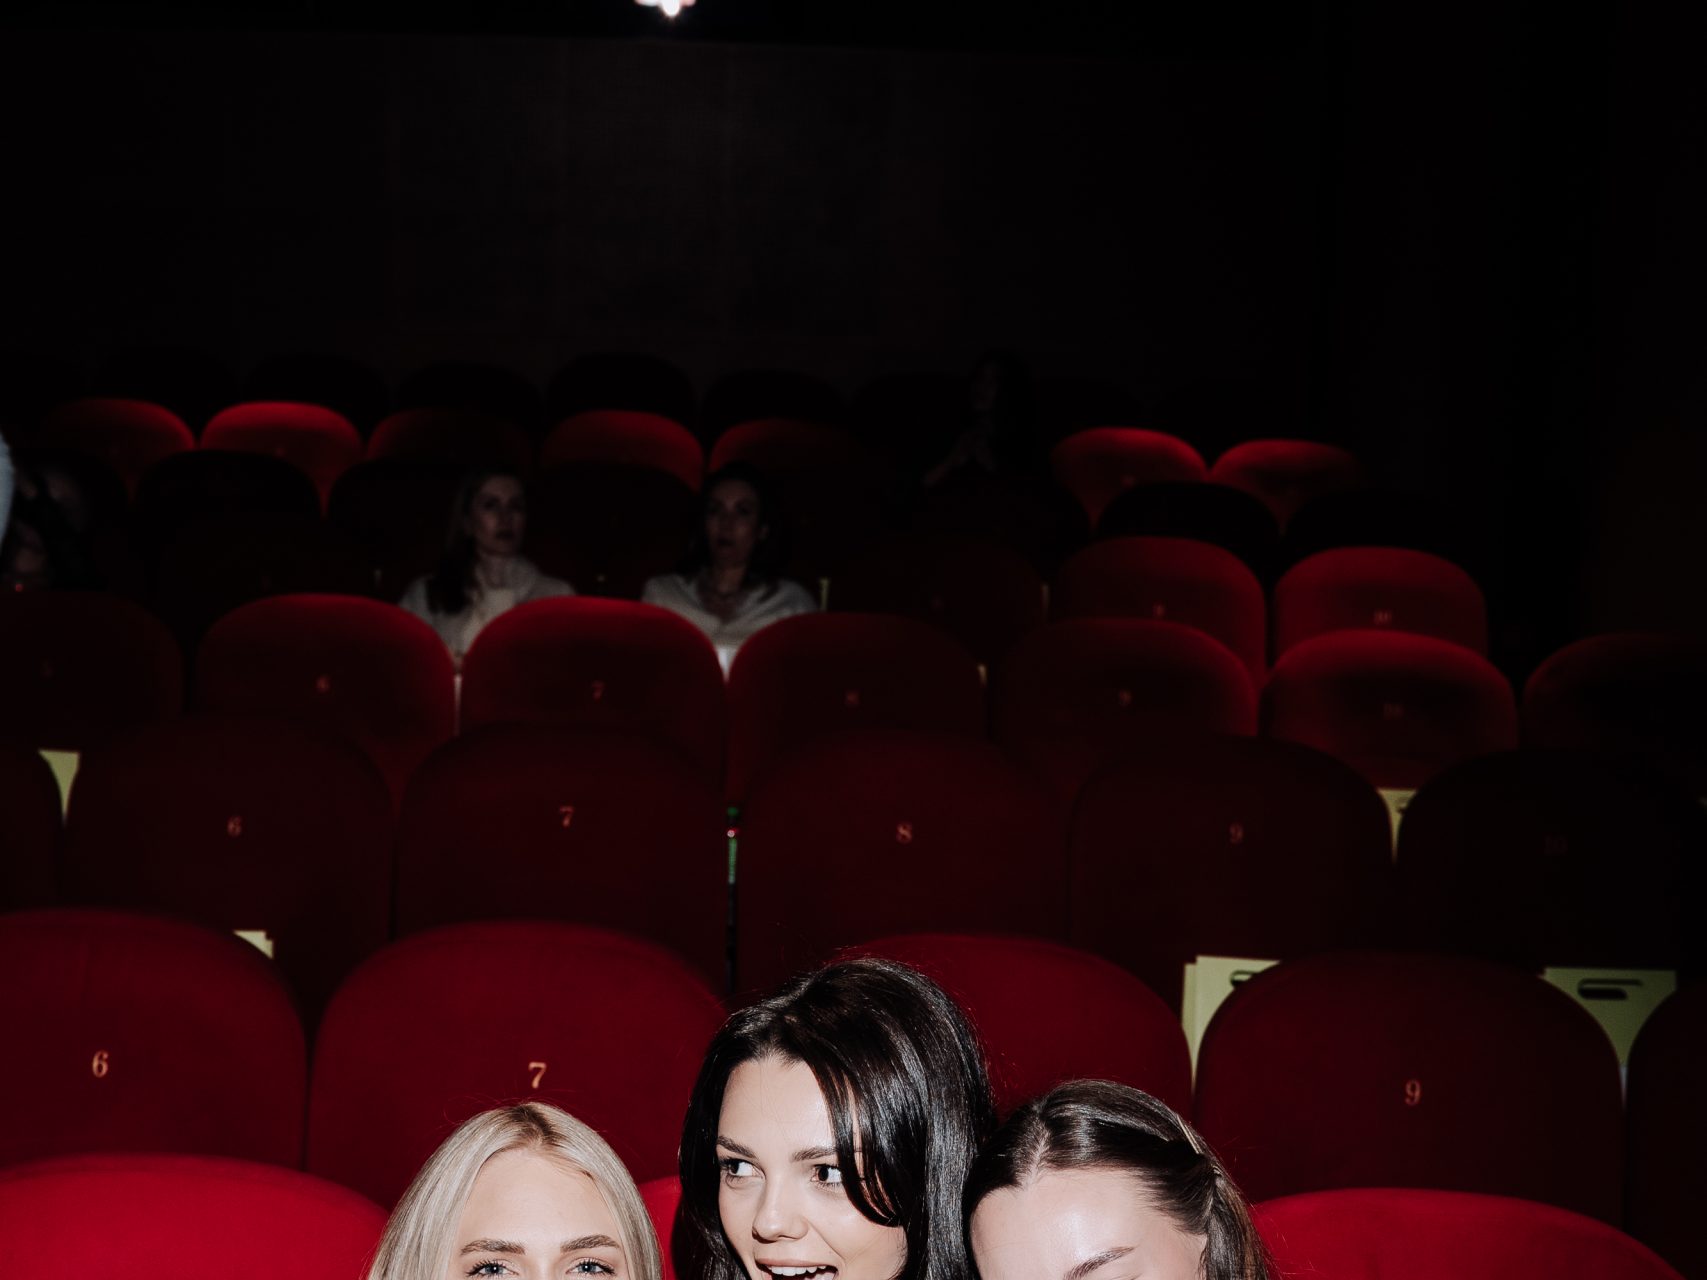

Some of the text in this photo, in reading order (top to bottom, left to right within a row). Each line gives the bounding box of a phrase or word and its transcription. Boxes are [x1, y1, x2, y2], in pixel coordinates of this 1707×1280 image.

[559, 805, 576, 828] 7
[896, 821, 913, 845] 8
[92, 1050, 109, 1078] 6
[528, 1062, 547, 1089] 7
[1403, 1078, 1423, 1106] 9
